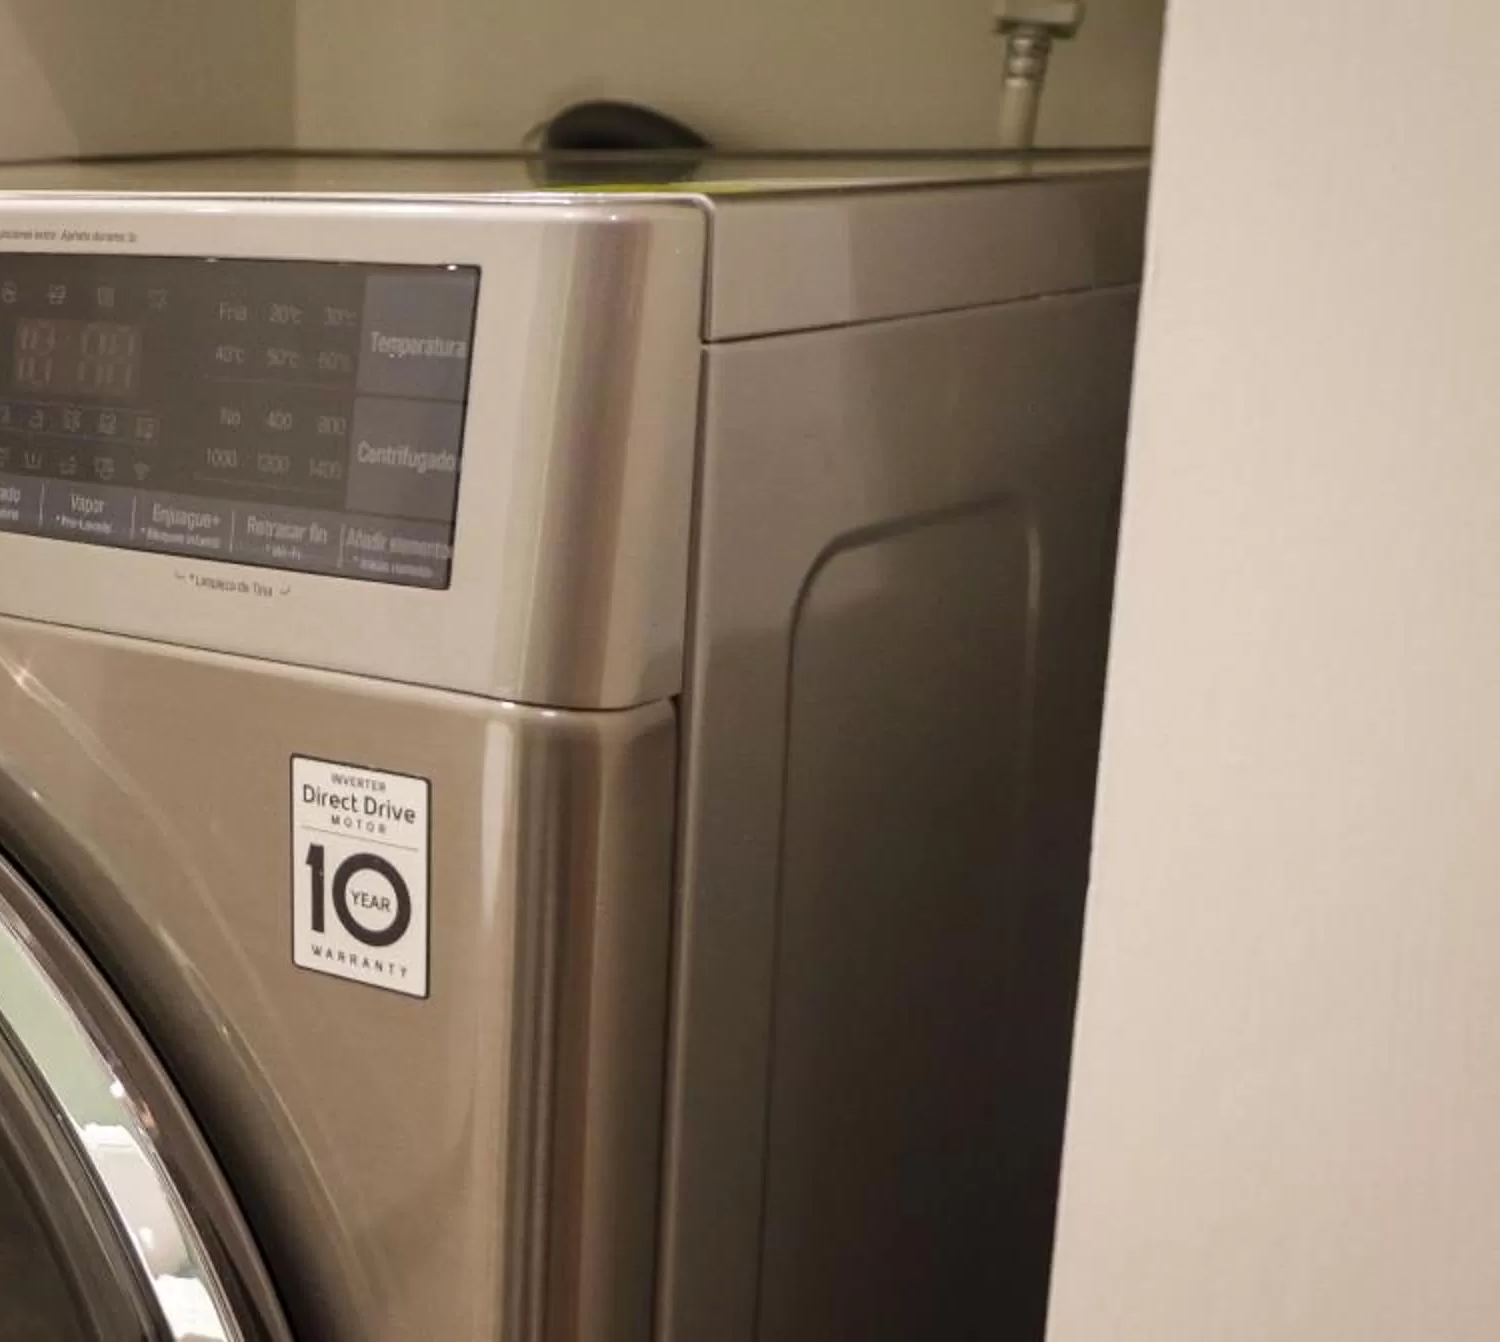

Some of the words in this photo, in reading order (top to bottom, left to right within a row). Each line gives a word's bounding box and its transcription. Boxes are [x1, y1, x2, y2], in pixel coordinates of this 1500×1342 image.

[371, 331, 467, 359] Temperatura
[357, 441, 459, 475] Centrifugado
[70, 493, 105, 515] Vapor
[152, 503, 221, 531] Enjuague+
[247, 516, 306, 543] Retrasar
[331, 772, 386, 793] INVERTER
[303, 783, 359, 813] Direct
[364, 795, 416, 824] Drive
[331, 815, 387, 834] MOTOR
[305, 842, 412, 947] 10
[351, 889, 392, 912] YEAR
[311, 944, 408, 978] WARRANTY
